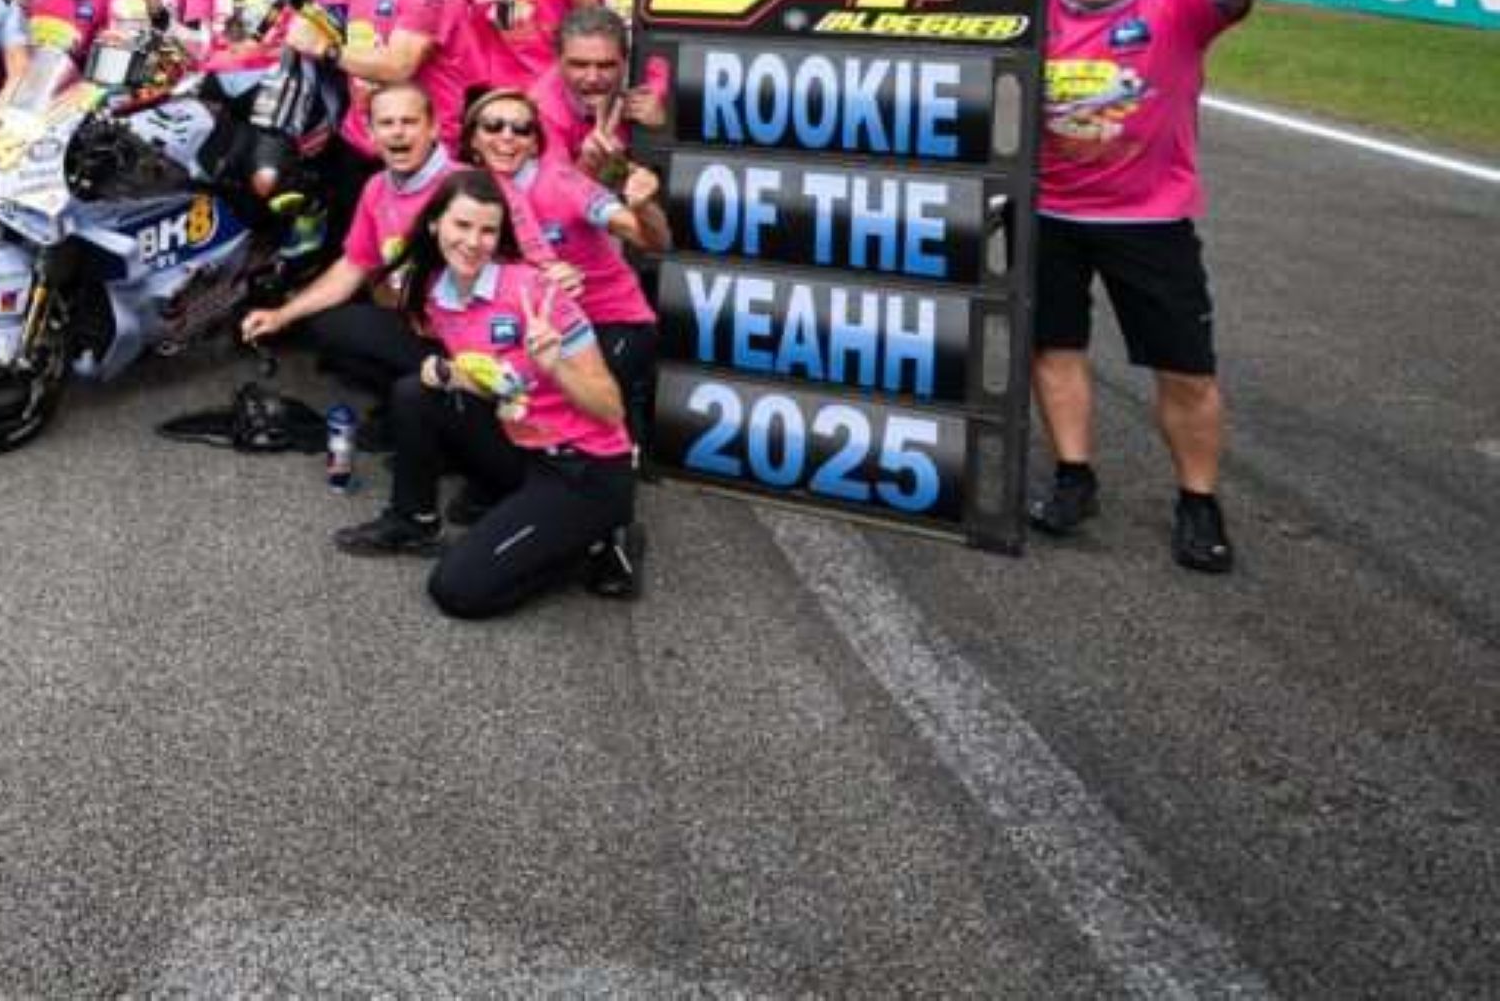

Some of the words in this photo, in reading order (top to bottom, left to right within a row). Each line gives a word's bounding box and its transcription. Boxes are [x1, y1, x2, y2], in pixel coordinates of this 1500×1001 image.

[702, 52, 961, 157] ROOKIE
[693, 164, 778, 256] OF
[803, 172, 950, 278] THE
[684, 270, 936, 397] YEAHH
[684, 383, 940, 513] 2025
